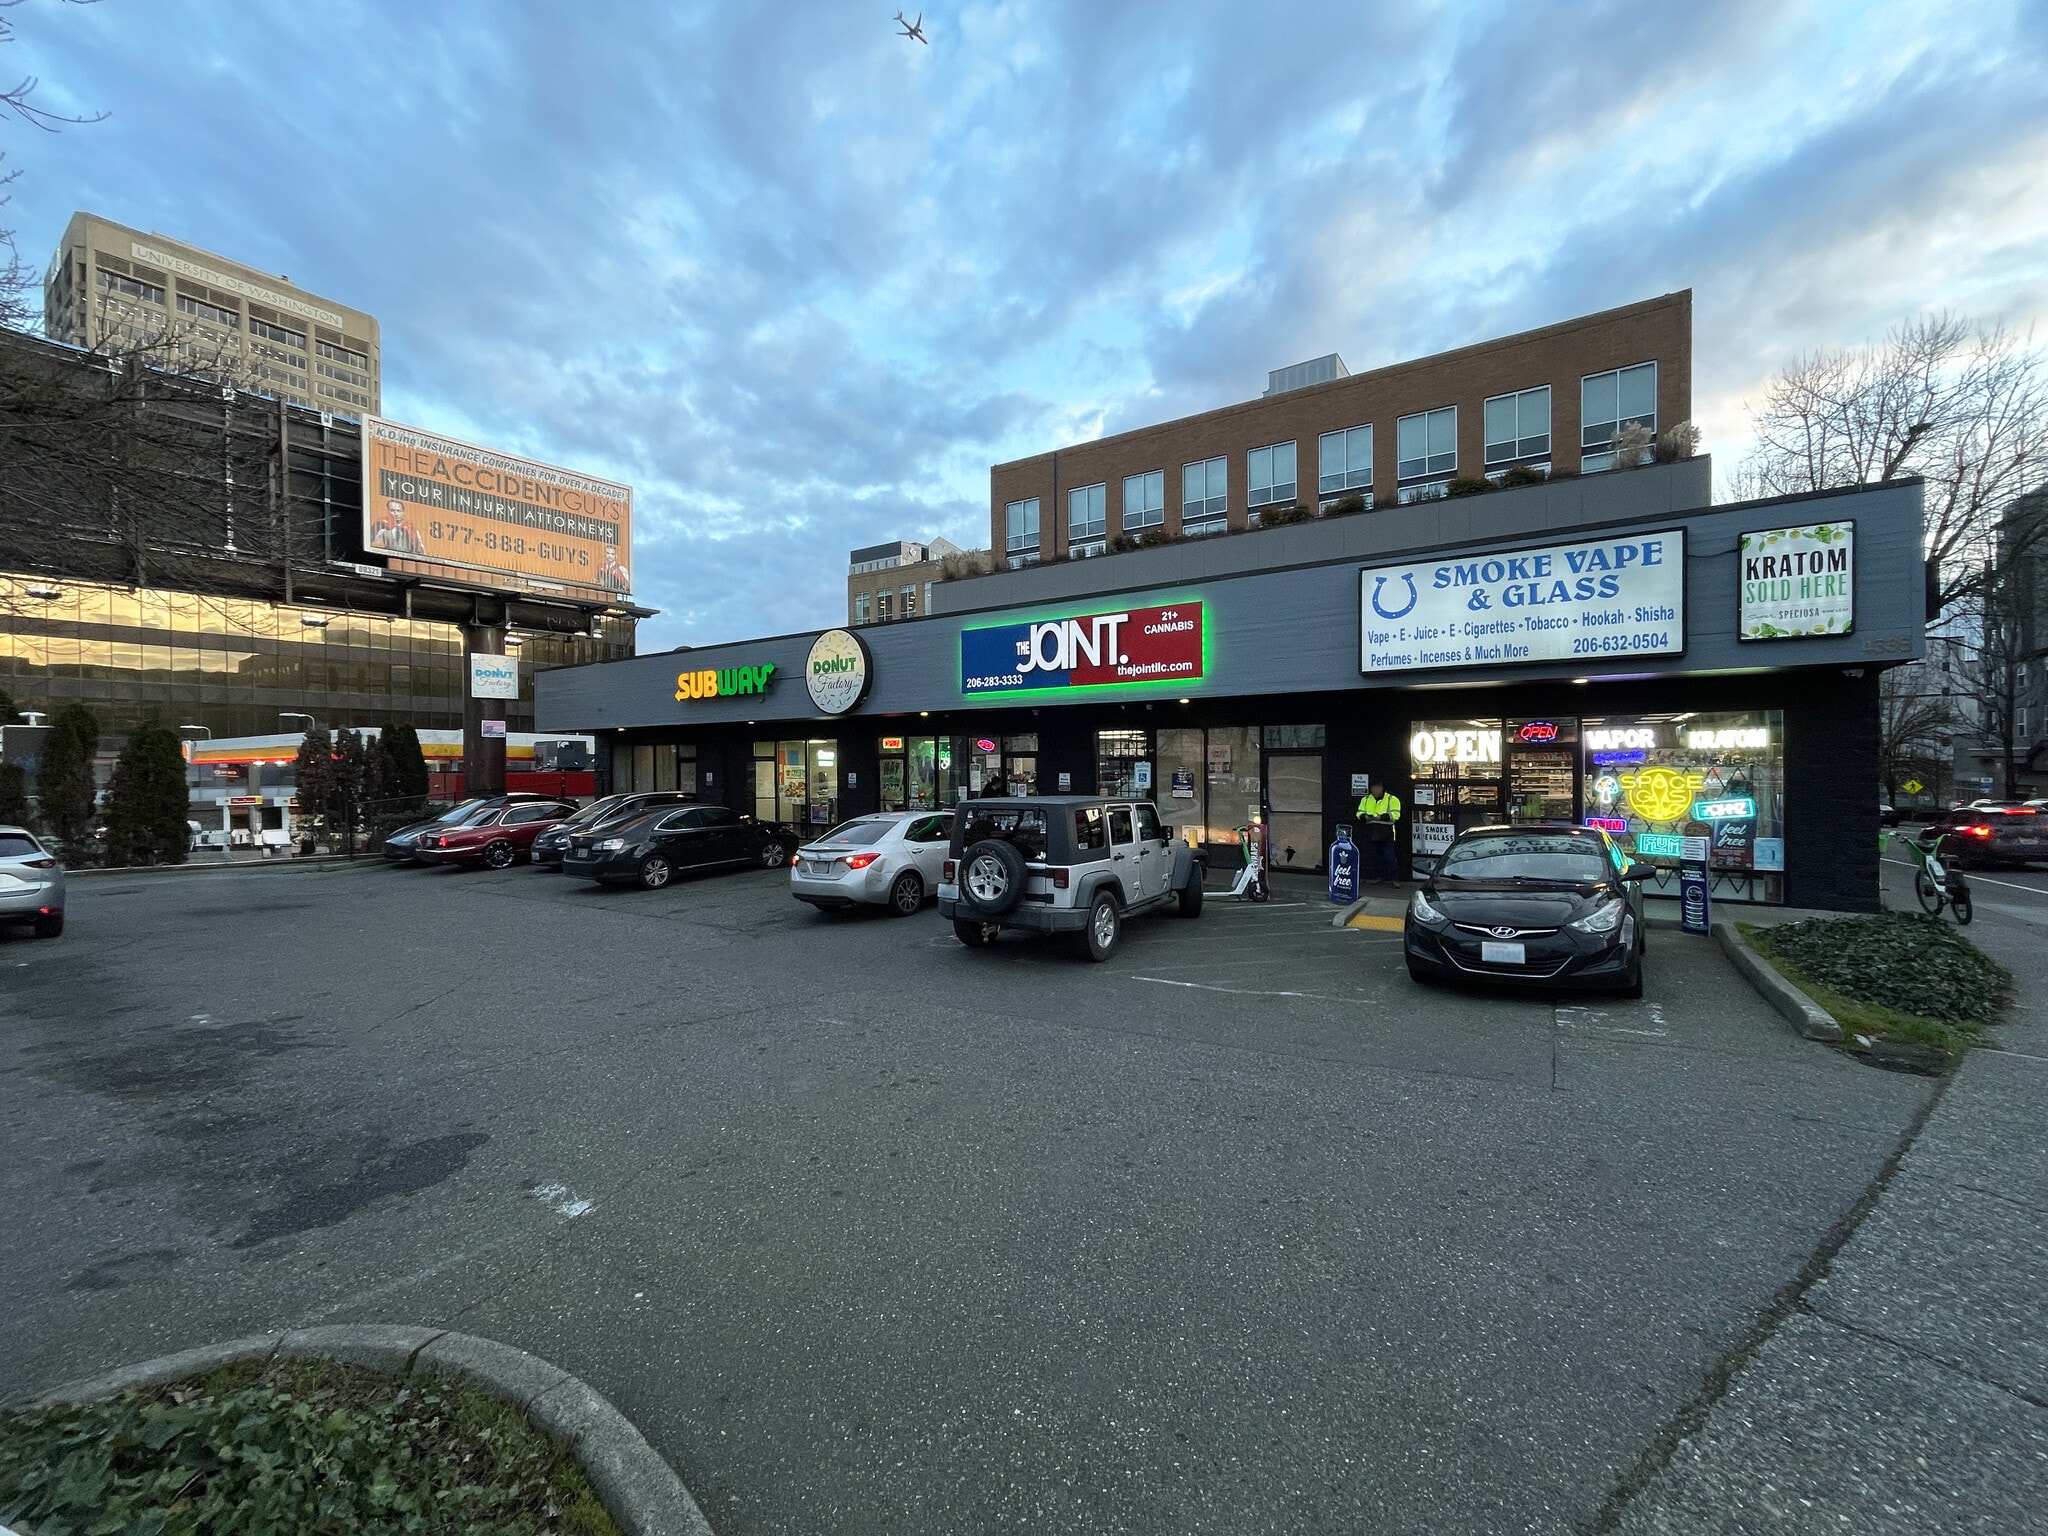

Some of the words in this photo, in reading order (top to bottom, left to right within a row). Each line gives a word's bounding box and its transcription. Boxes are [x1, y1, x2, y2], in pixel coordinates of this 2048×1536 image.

[137, 247, 221, 283] UNIVERSITY
[226, 279, 245, 290] OF
[249, 286, 340, 325] WASHINGTON
[420, 441, 480, 463] INSURANCE
[482, 456, 537, 477] COMPANIES
[540, 471, 557, 482] FOR
[560, 476, 581, 488] OVER
[387, 478, 442, 500] YOUR
[453, 493, 516, 516] INJURY
[525, 511, 613, 538] ATTORNEYS
[429, 520, 589, 567] 877-888-GUYS
[1433, 554, 1552, 589] SMOKE
[1564, 540, 1663, 574] VAPE
[1746, 548, 1847, 581] KRATOM
[1467, 588, 1493, 611] &
[1502, 574, 1620, 608] GLASS
[1746, 579, 1791, 604] SOLD
[1800, 573, 1847, 599] HERE
[1161, 611, 1179, 621] 21+
[1778, 608, 1820, 620] SPECIOSA
[1144, 620, 1194, 635] CANNABIS
[1368, 631, 1390, 647] Vape
[1413, 626, 1439, 641] Juice
[1464, 618, 1515, 637] Cigarettes
[1524, 615, 1569, 631] Tobacco
[1582, 609, 1624, 627] Hookah
[1635, 605, 1675, 623] Shisha
[1016, 641, 1031, 655] THE
[1573, 632, 1669, 654] 206-632-0504
[813, 654, 857, 674] DONUT
[1370, 652, 1412, 668] Perfumes
[1419, 647, 1462, 663] Incenses
[1465, 647, 1472, 661] &
[1475, 644, 1501, 660] Much
[1504, 643, 1529, 658] More
[475, 668, 514, 678] DONUT
[1117, 661, 1193, 677] thejointllc.com
[674, 662, 776, 701] SUBWAY
[814, 673, 858, 694] Factory
[966, 674, 1023, 688] 206-283-3333
[1521, 725, 1559, 738] OPEN
[1585, 729, 1656, 750] VAPOR
[1688, 728, 1767, 748] KRATOM
[1412, 730, 1502, 762] OPEN
[1621, 773, 1704, 790] SPACE
[1636, 790, 1686, 803] GAS
[1590, 820, 1624, 831] ATM
[1720, 823, 1747, 836] feel
[1643, 836, 1680, 852] FLUM
[1717, 834, 1746, 847] free
[1334, 864, 1352, 876] feel
[1333, 874, 1352, 887] free
